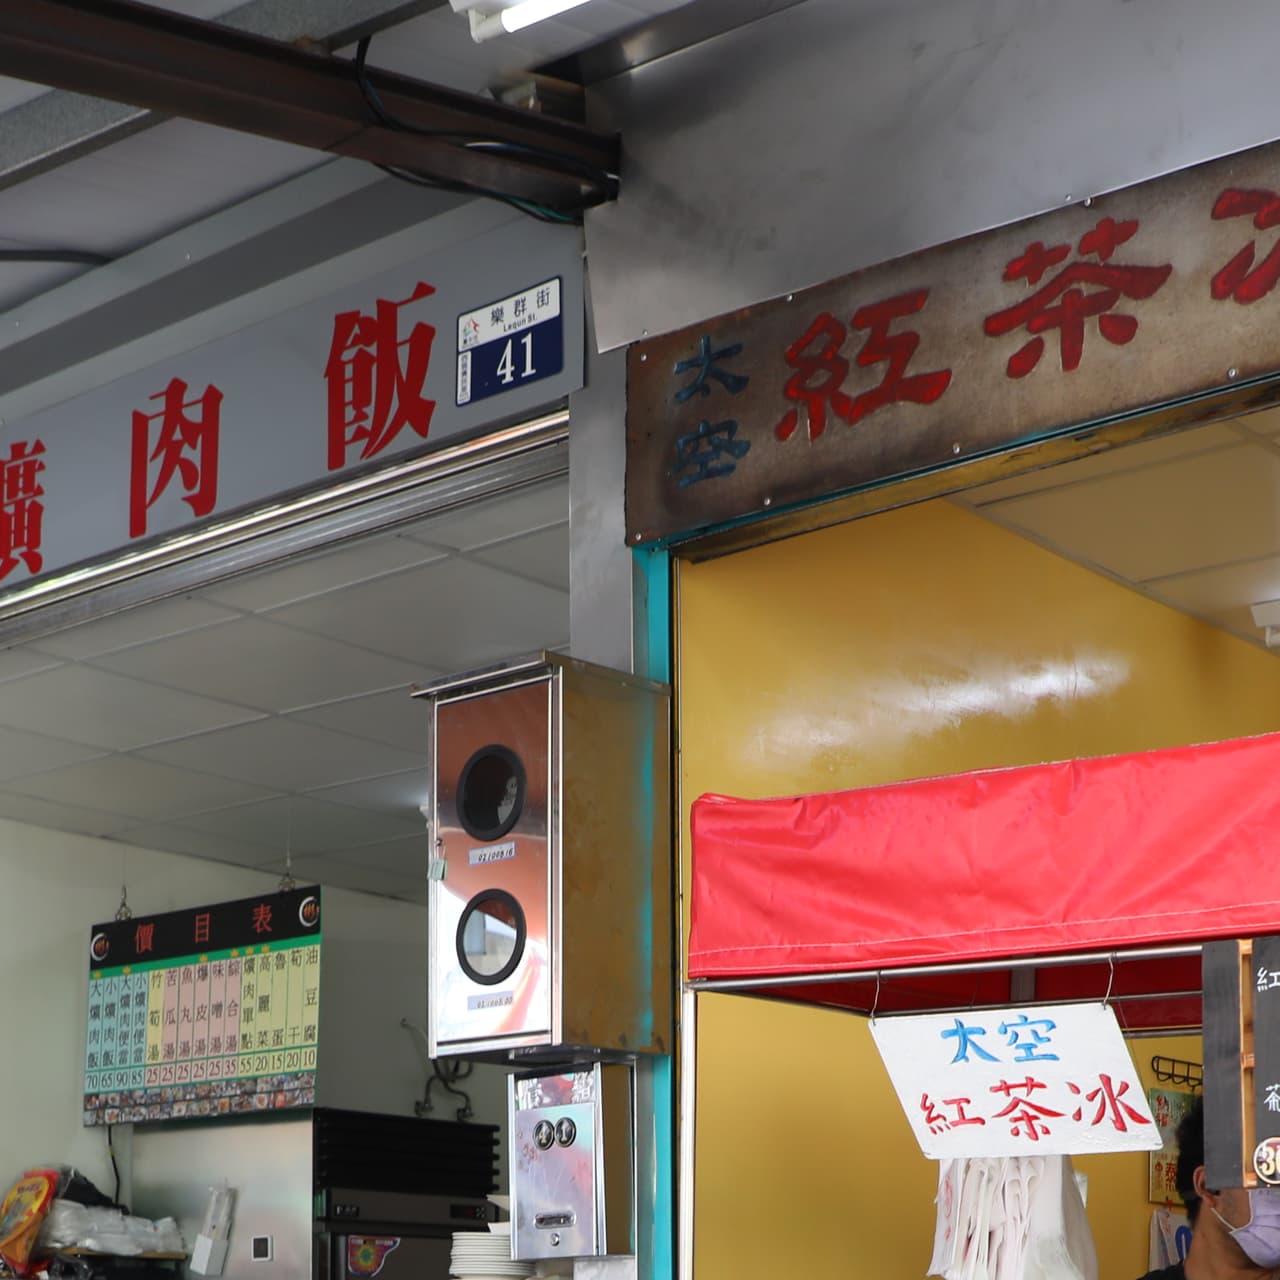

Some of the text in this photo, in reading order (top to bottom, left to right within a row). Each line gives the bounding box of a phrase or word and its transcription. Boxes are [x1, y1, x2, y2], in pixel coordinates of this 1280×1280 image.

[490, 287, 551, 327] 樂群街
[496, 331, 537, 385] 41
[671, 334, 751, 490] 太空
[135, 903, 273, 953] 價目表
[257, 954, 271, 1049] 高麗菜
[303, 944, 318, 1043] 油豆腐
[178, 967, 193, 1058] 魚丸湯
[939, 1013, 1060, 1065] 太空
[240, 1057, 252, 1073] 55
[255, 1055, 268, 1071] 20
[271, 1053, 283, 1070] 15
[286, 1051, 299, 1068] 20
[302, 1049, 316, 1066] 10
[146, 1067, 158, 1083] 25
[161, 1066, 174, 1082] 25
[177, 1064, 190, 1080] 25
[193, 1062, 205, 1078] 25
[209, 1060, 221, 1077] 25
[224, 1058, 237, 1075] 35
[86, 1074, 99, 1090] 70
[101, 1072, 113, 1088] 65
[116, 1071, 129, 1086] 90
[131, 1069, 143, 1084] 85
[919, 1073, 1153, 1142] 紅茶冰
